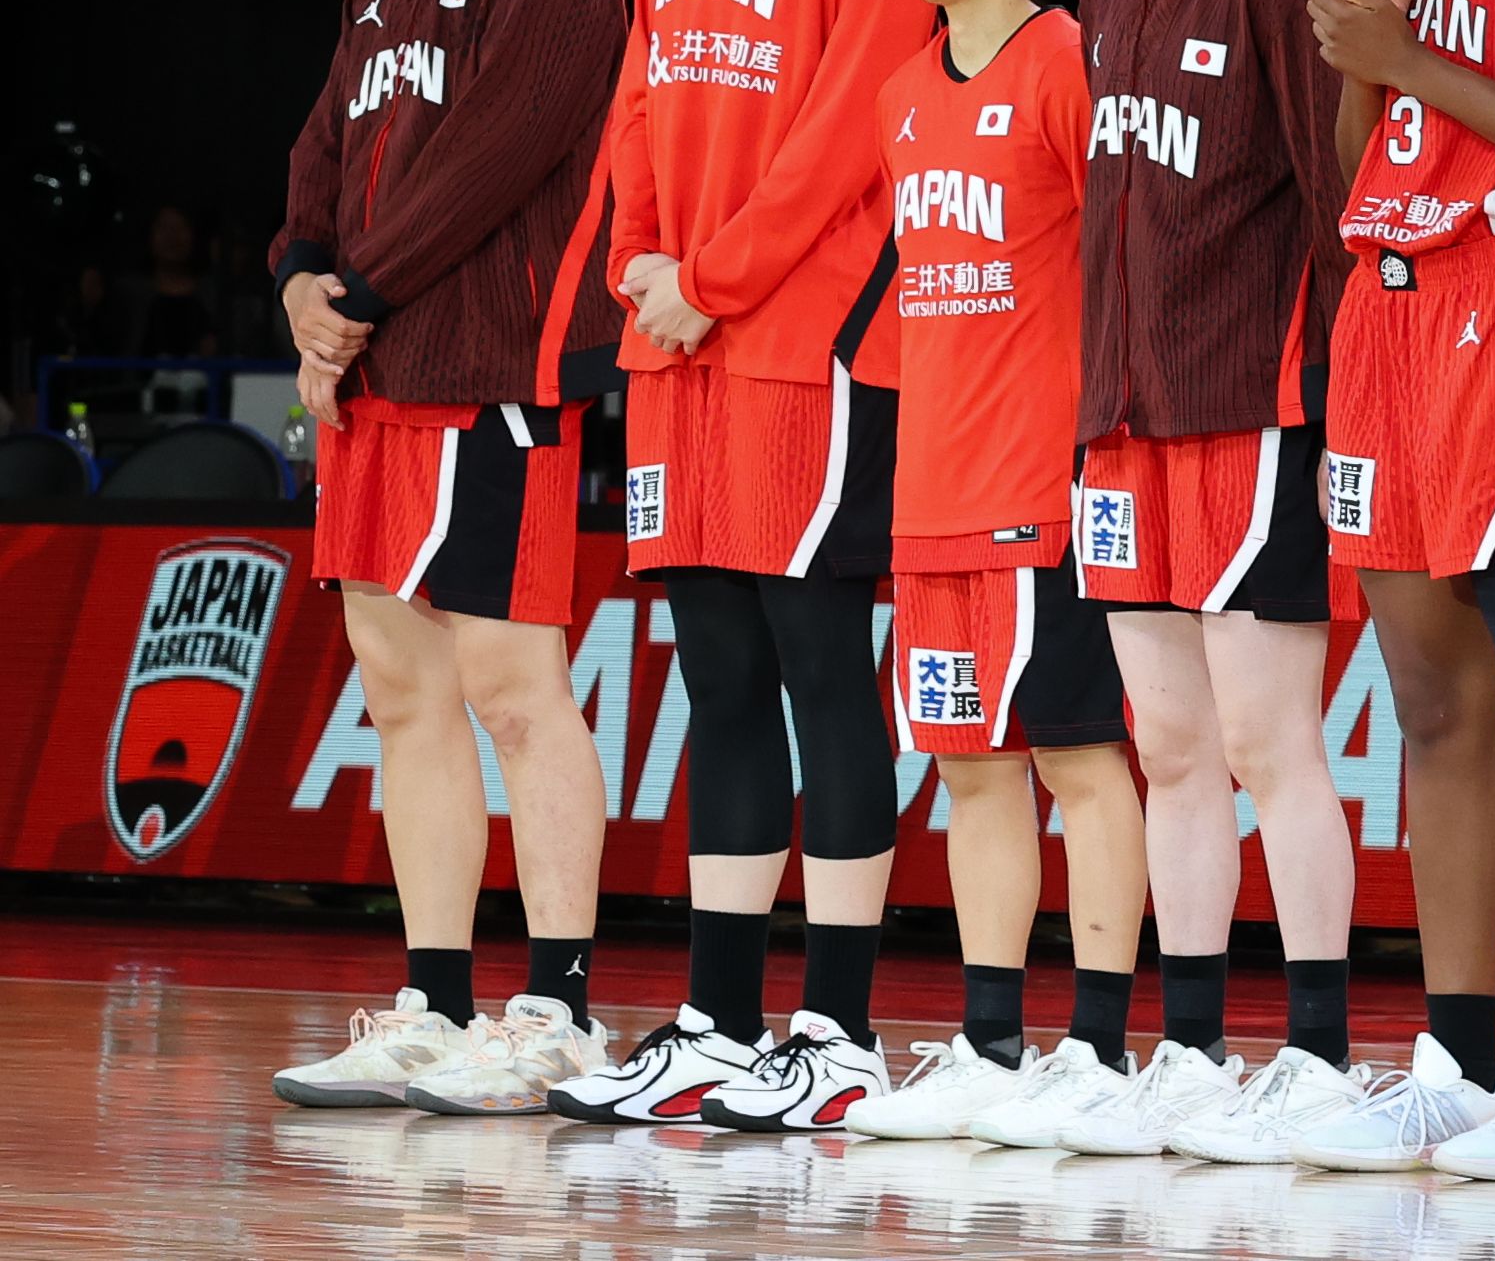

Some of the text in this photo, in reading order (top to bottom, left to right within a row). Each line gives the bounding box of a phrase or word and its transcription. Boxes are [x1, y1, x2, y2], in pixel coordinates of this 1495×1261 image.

[673, 63, 710, 83] TSUI
[1086, 93, 1201, 179] APAN
[1387, 95, 1423, 165] 3
[902, 260, 1015, 296] 三井不動産
[937, 295, 1016, 317] FUDOSAN
[1337, 459, 1363, 529] 買取
[1091, 494, 1119, 563] 大吉
[150, 558, 275, 637] JAPAN
[136, 631, 250, 679] BASKETBALL
[918, 654, 948, 720] 大吉
[951, 656, 982, 720] 買取
